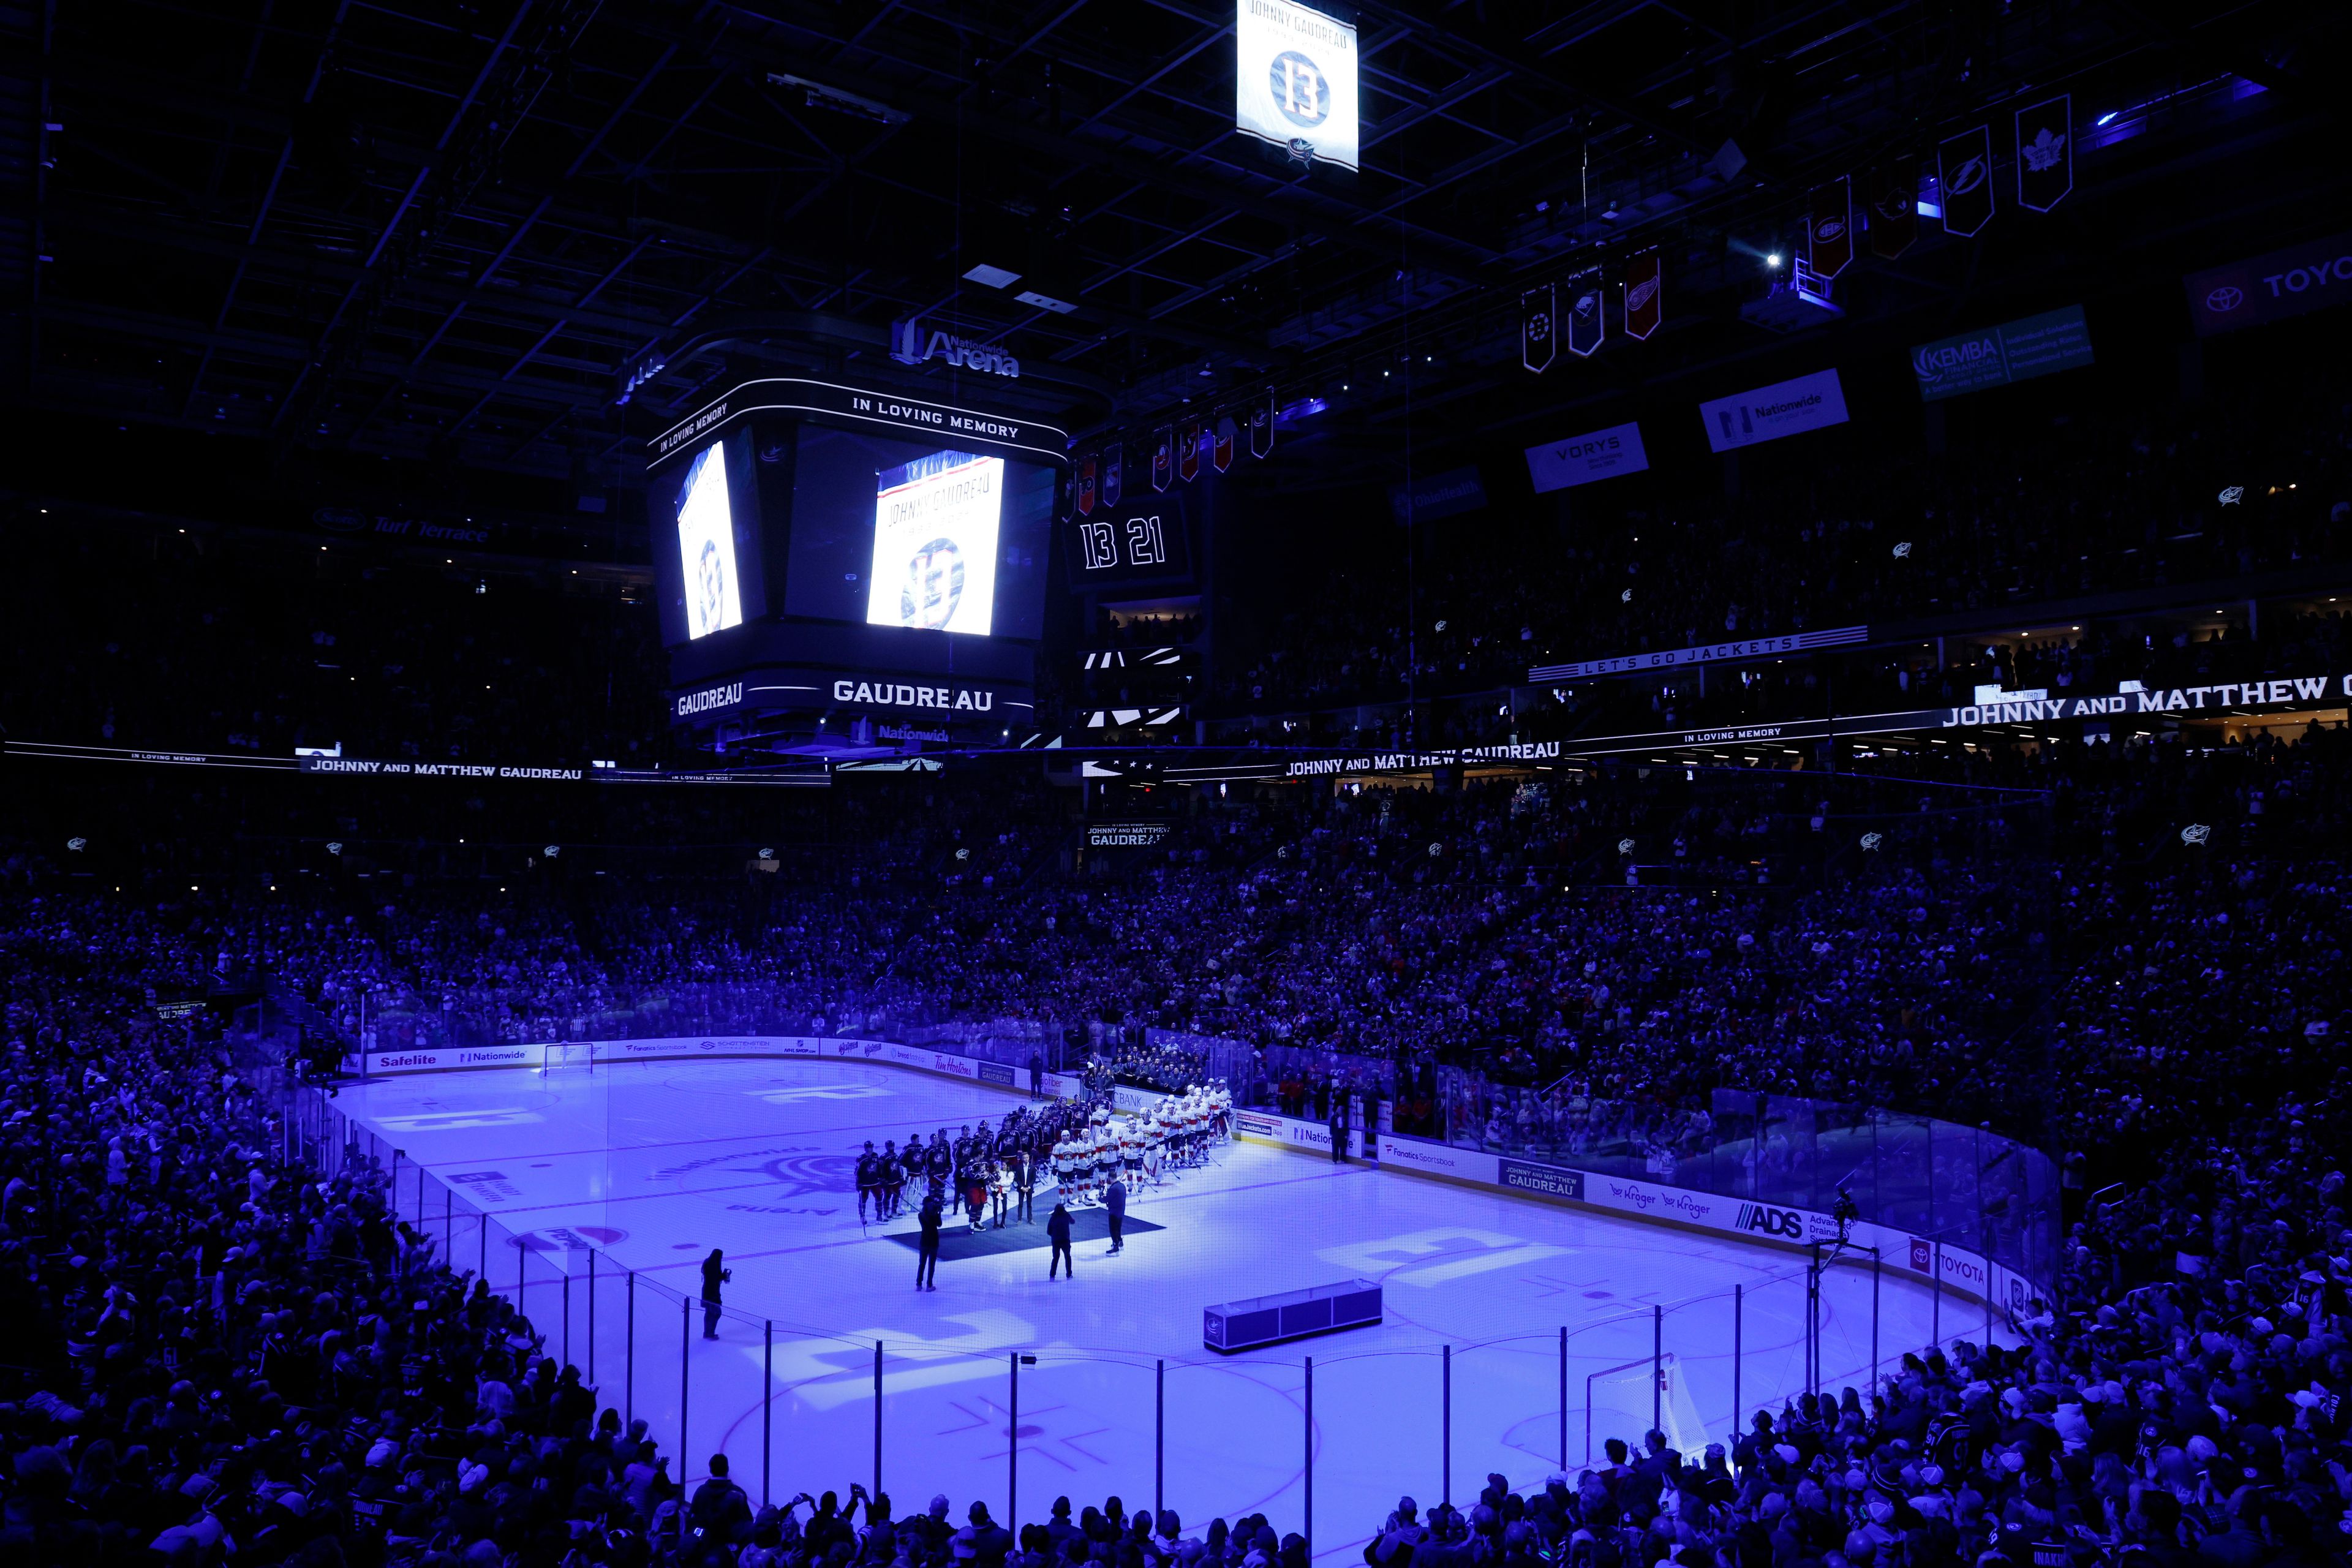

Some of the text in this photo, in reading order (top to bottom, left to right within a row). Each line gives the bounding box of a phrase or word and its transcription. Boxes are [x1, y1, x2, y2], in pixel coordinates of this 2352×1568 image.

[1250, 0, 1347, 49] JOHNNY GAUDREAU
[1281, 57, 1319, 119] 13
[2006, 321, 2083, 345] Individual Solutions
[922, 331, 1020, 378] Arena
[950, 336, 1009, 356] Nationwide
[1927, 338, 1997, 370] KEMBA
[2008, 334, 2082, 357] Outstanding Rates
[2013, 345, 2092, 369] Personalized Service
[1944, 356, 1999, 375] FINANCIAL
[1755, 394, 1822, 418] Nationwide
[660, 402, 728, 453] IN LOVING MEMORY
[853, 398, 1019, 439] IN LOVING MEMORY
[1556, 437, 1620, 460] VORYS
[933, 472, 990, 511] GAUDREAU
[1415, 480, 1480, 508] OhioHealth
[374, 516, 413, 534] Turf
[418, 521, 489, 543] Terrace
[1080, 516, 1166, 570] 13 21
[1585, 638, 1792, 674] LET'S GO JACKETS
[678, 682, 742, 717] GAUDREAU
[834, 680, 992, 712] GAUDREAU
[1943, 698, 2066, 728] JOHNNY
[2073, 695, 2127, 715] AND
[2137, 676, 2329, 713] MATTHEW
[1684, 727, 1782, 742] IN LOVING MEMORY
[311, 760, 582, 780] JOHNNY AND MATTHEW GAUDREAU
[1286, 759, 1343, 776] JOHNNY
[1346, 758, 1370, 771] AND
[380, 1055, 436, 1067] Safelite
[473, 1052, 526, 1061] Nationwide
[935, 1055, 947, 1069] Tim
[948, 1058, 972, 1076] Hortons
[982, 1071, 1011, 1084] GAUDREAU
[1237, 1121, 1271, 1134] BlueJackets.com
[1305, 1130, 1354, 1149] Natione
[1393, 1147, 1455, 1167] Fanatics Sportsbook
[1506, 1166, 1531, 1176] JOHNNY
[1544, 1174, 1577, 1185] MATTHEW
[1509, 1174, 1574, 1196] GAUDREAU
[1624, 1185, 1711, 1219] Kroger Kroger
[1749, 1204, 1803, 1238] ADS
[1940, 1254, 1985, 1286] TOYOTA
[164, 1347, 177, 1365] 61
[1926, 1433, 1936, 1446] 91
[2139, 1444, 2151, 1458] 16
